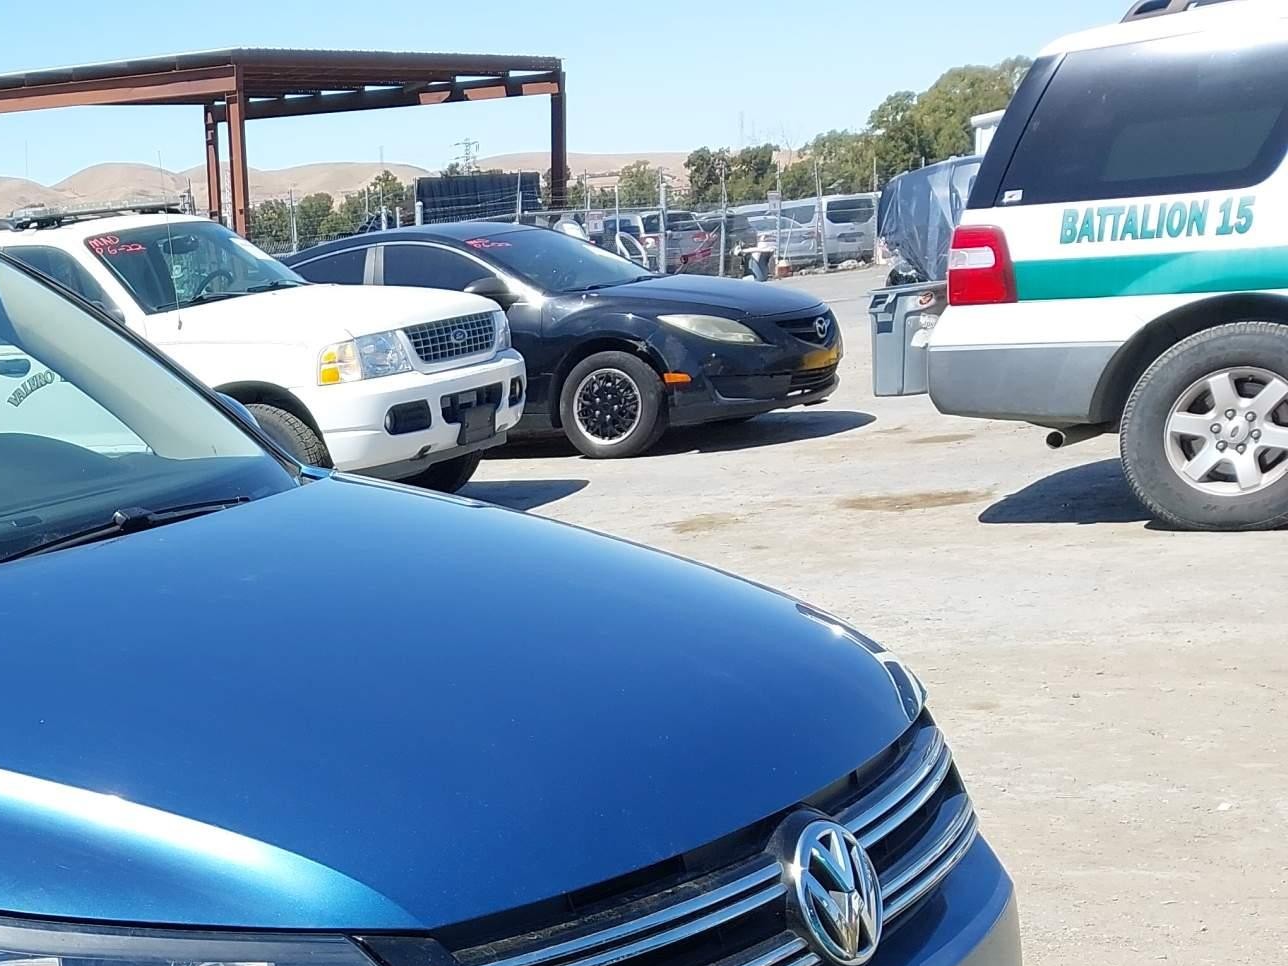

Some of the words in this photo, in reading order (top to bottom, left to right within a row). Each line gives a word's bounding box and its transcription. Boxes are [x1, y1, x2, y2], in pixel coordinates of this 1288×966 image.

[1059, 198, 1210, 244] BATTALION
[1215, 195, 1256, 236] 15
[7, 369, 55, 407] VALERO
